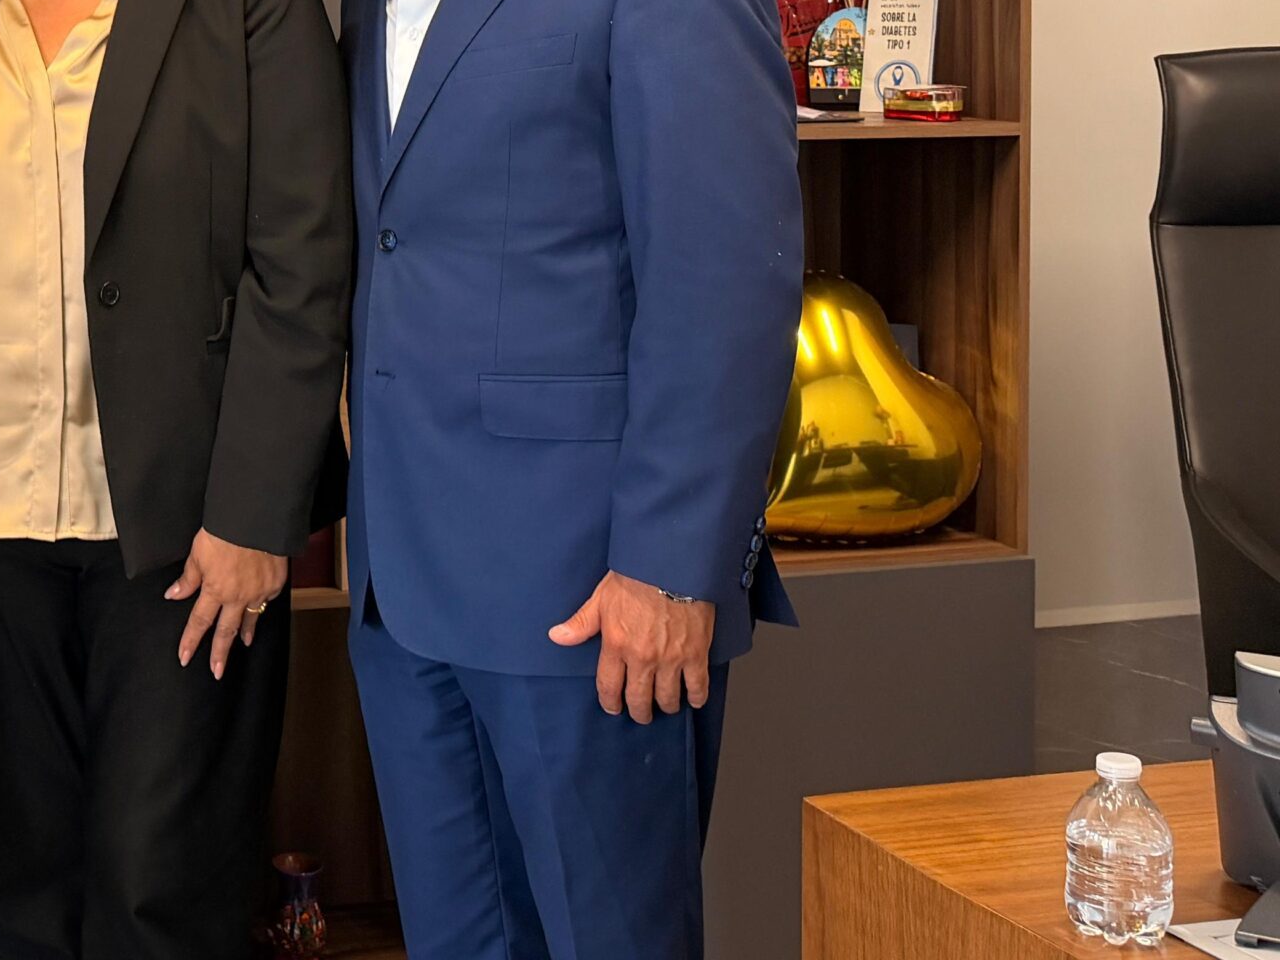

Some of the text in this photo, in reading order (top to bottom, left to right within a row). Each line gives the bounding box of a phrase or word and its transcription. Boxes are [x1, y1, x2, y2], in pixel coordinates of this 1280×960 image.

[881, 12, 917, 22] SOBRE LA
[881, 25, 917, 36] DIABETES
[887, 39, 911, 50] TIPO 1
